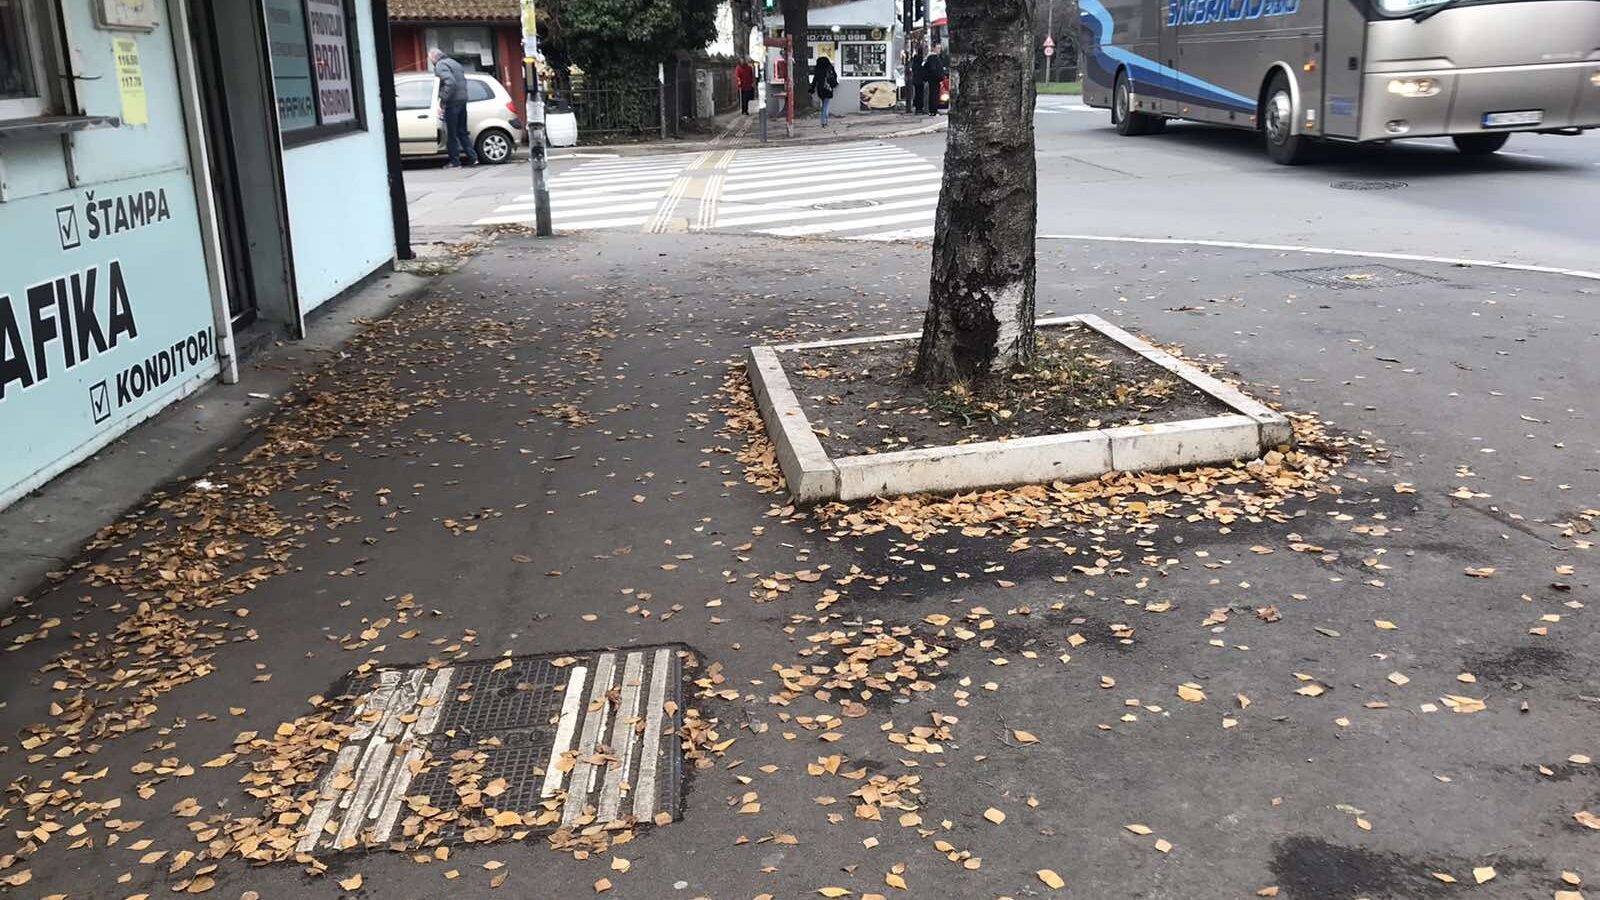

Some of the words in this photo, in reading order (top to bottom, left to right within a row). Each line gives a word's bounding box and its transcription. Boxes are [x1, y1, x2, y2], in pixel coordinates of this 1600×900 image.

[314, 44, 342, 81] BRZO
[86, 189, 171, 240] ŠTAMPA
[116, 326, 213, 408] KONDITORI
